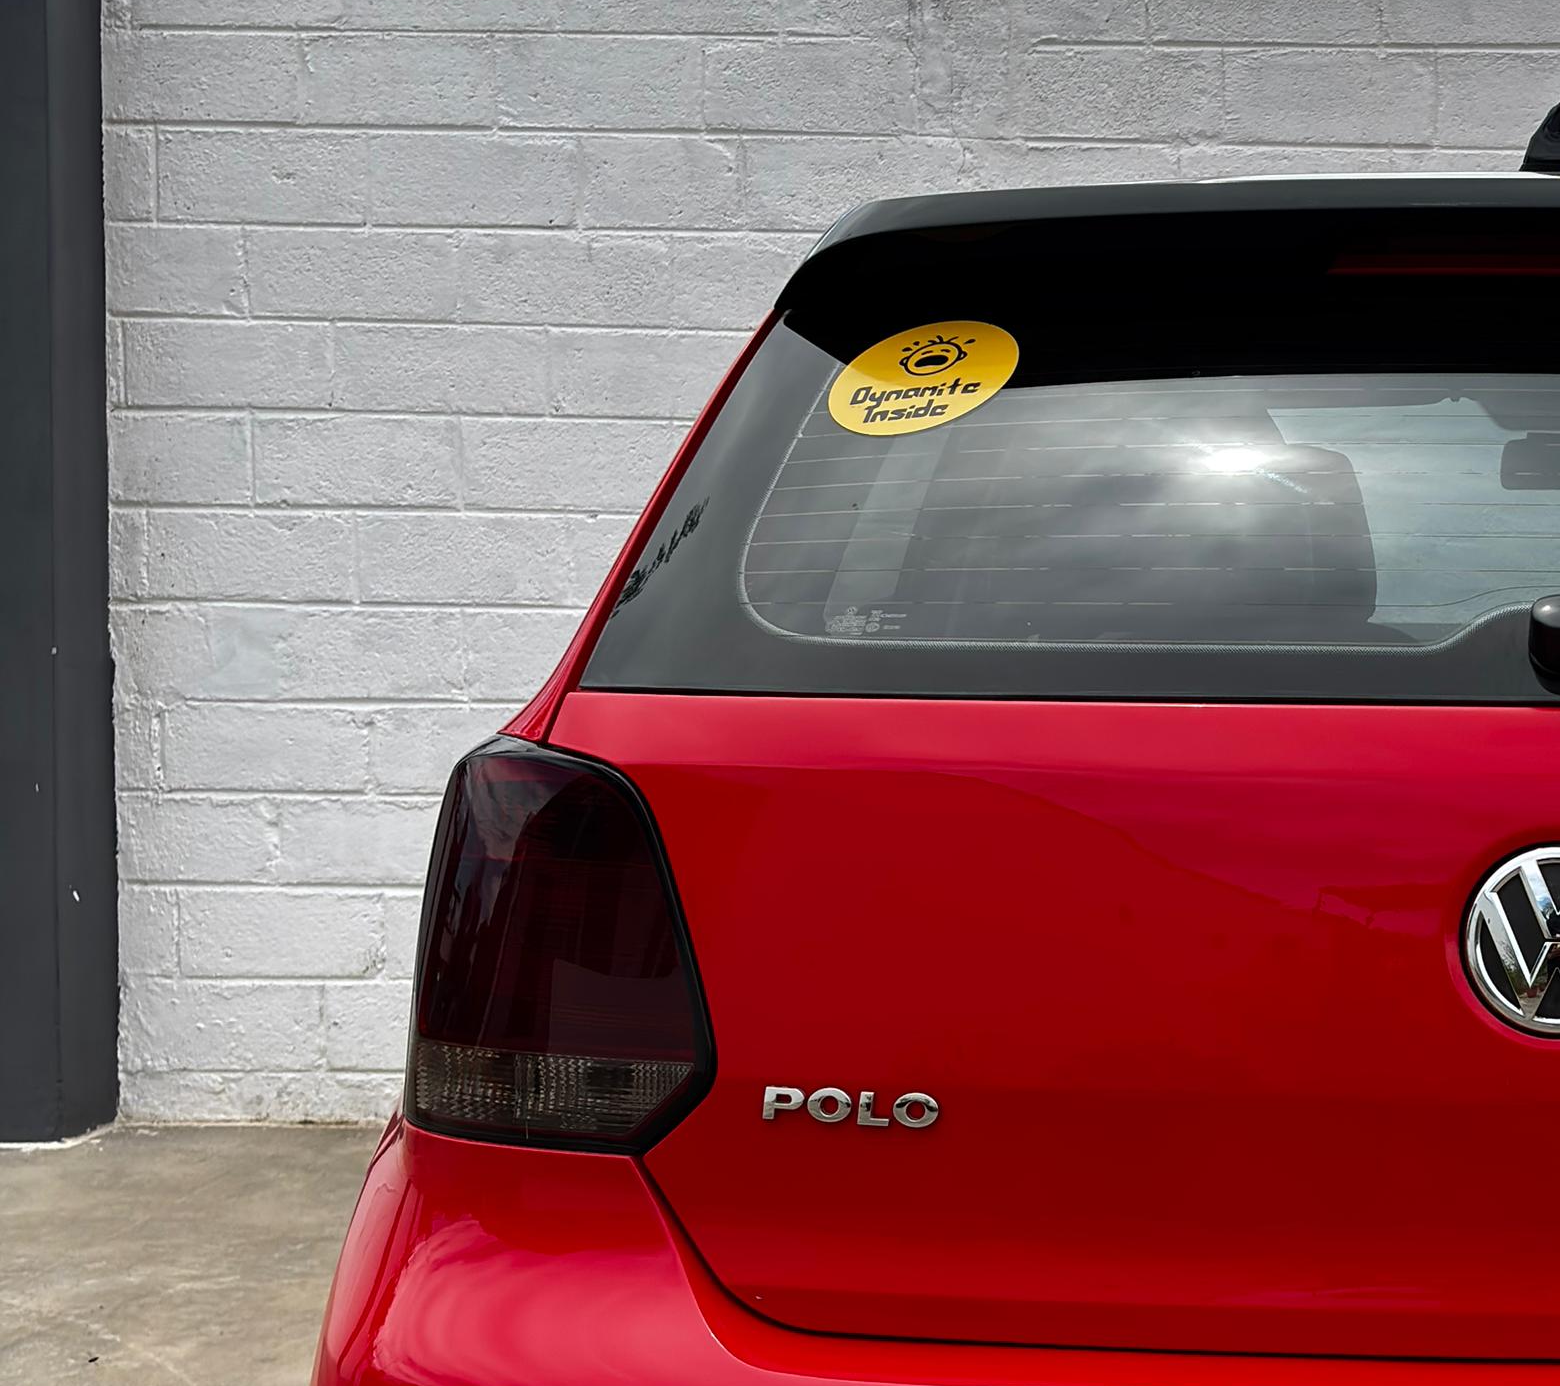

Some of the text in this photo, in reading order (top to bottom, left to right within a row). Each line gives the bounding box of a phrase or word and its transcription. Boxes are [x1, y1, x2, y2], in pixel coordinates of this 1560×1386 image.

[849, 377, 982, 407] Dynamite
[862, 399, 949, 424] Inside
[762, 1085, 940, 1129] POLO
